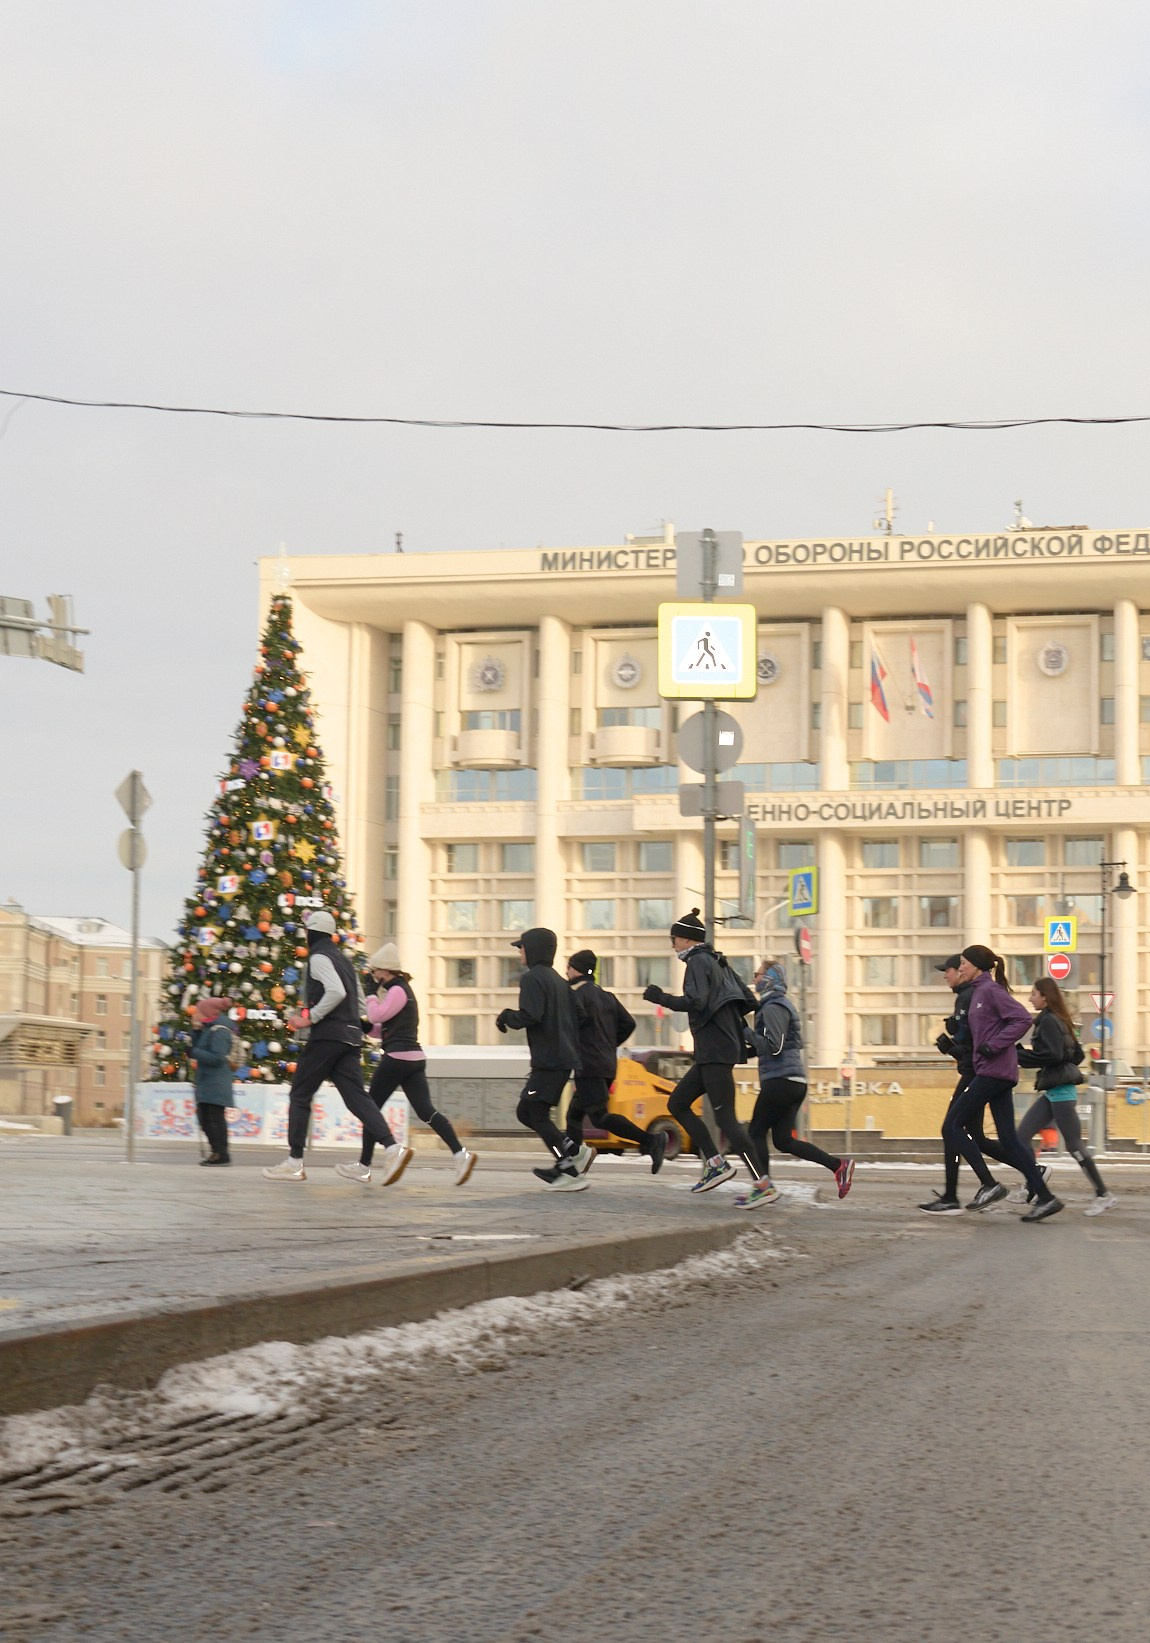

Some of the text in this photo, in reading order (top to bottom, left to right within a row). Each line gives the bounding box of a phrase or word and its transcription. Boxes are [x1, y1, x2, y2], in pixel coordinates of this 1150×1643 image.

[541, 546, 746, 571] МИНИСТЕР
[755, 541, 889, 565] ОБОРОНЫ
[899, 533, 1084, 561] РОССИЙСКОЙ
[736, 799, 1072, 822] ЕННО-СОЦИАЛЬНЫЙ ЦЕНТР
